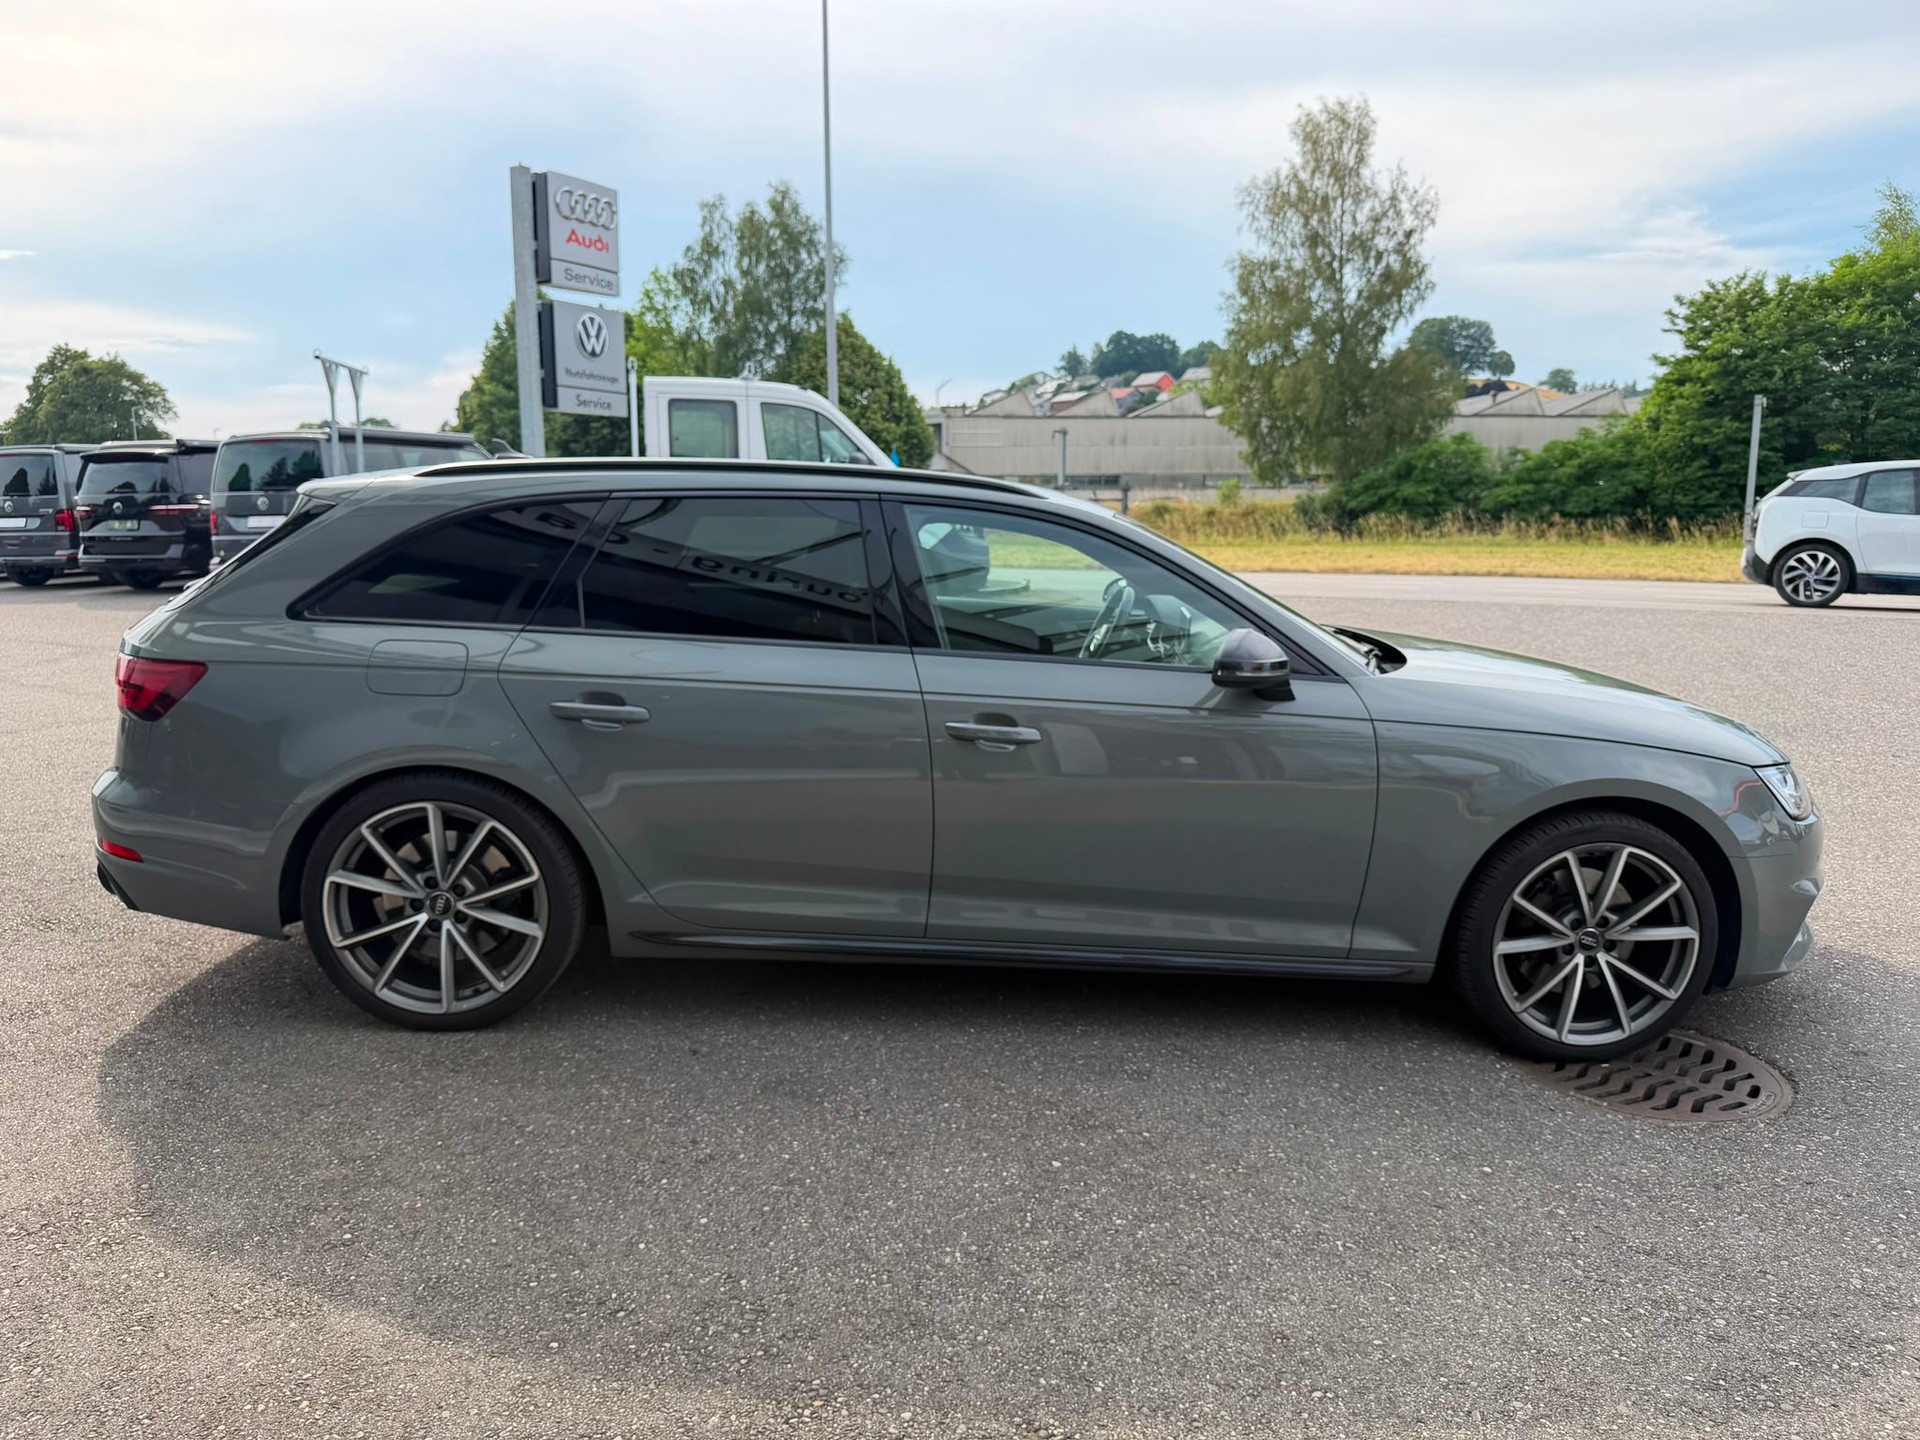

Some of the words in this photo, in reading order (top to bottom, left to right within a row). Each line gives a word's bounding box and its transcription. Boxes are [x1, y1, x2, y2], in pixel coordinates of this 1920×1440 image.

[566, 228, 609, 253] Audi
[564, 267, 614, 290] Service
[576, 394, 612, 411] Service
